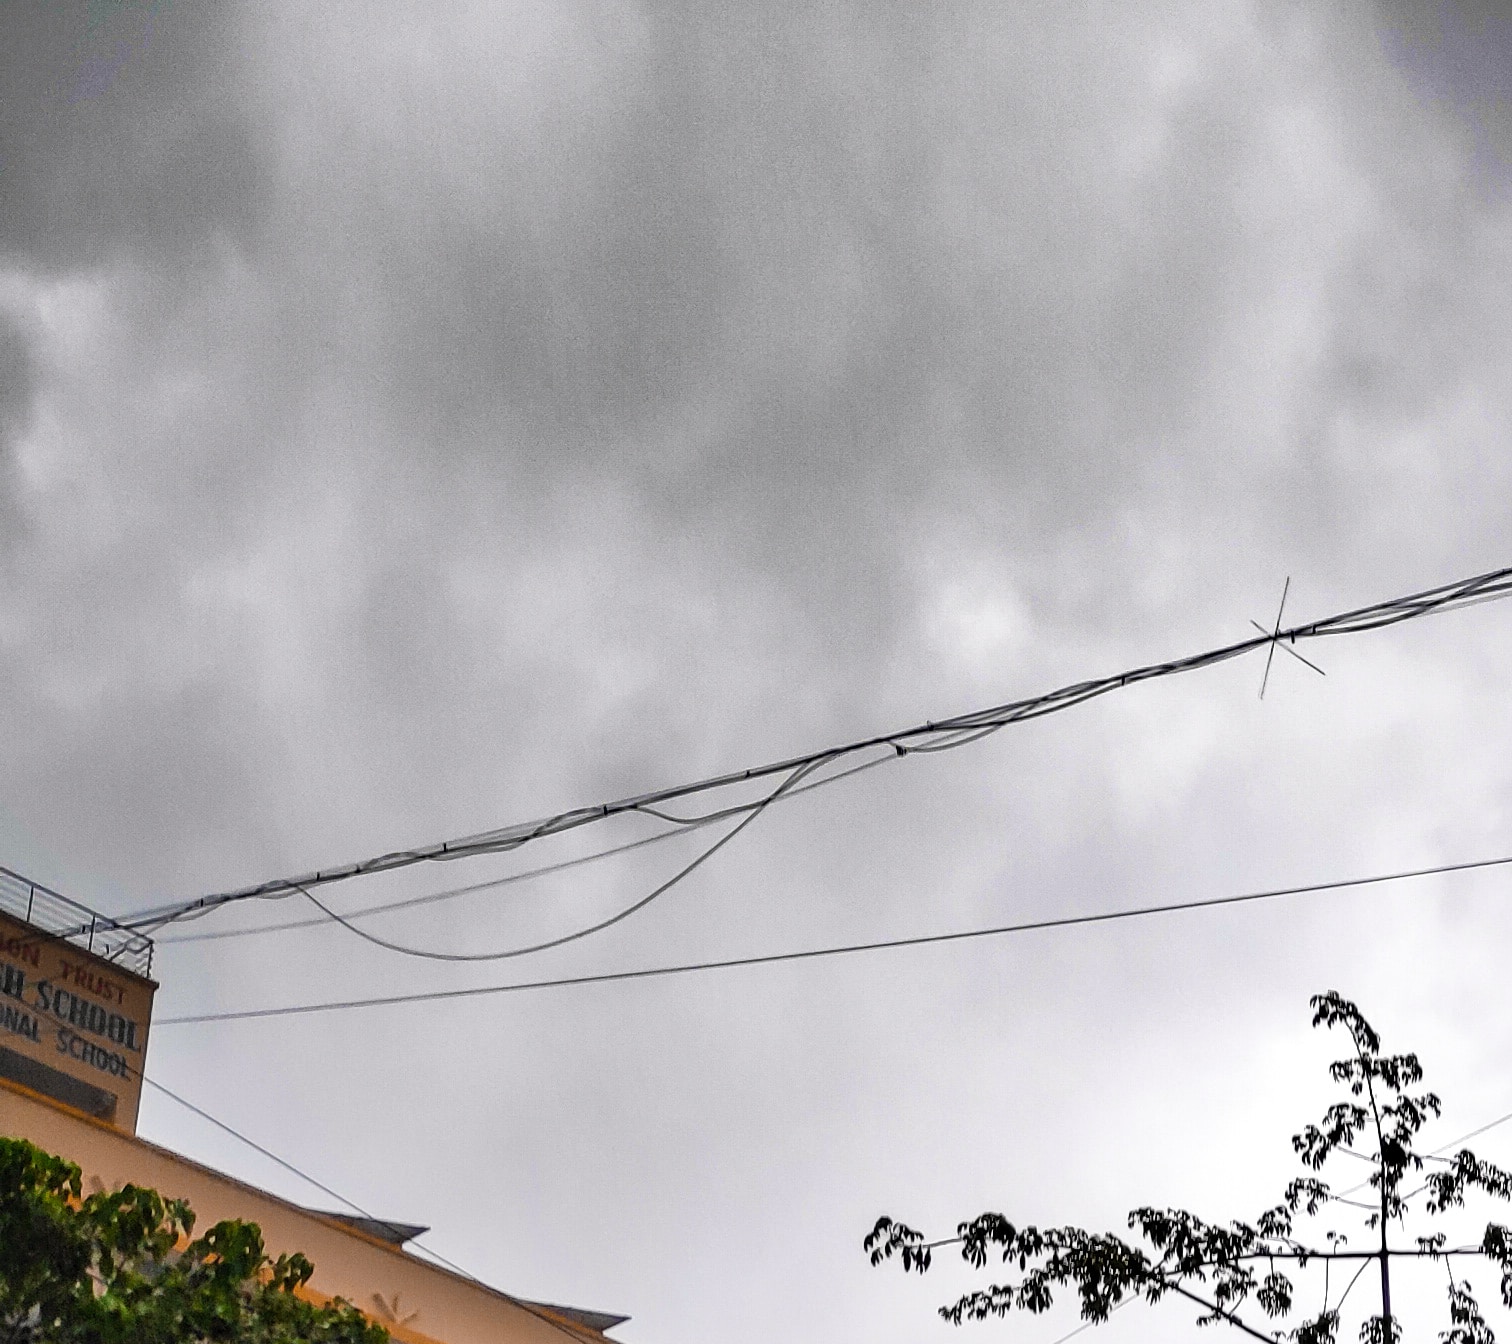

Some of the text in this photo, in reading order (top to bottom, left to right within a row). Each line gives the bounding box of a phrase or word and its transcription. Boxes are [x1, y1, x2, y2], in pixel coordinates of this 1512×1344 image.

[60, 960, 126, 1004] TRUST
[35, 980, 140, 1052] SCHOOL
[56, 1027, 131, 1081] SCHOOL
